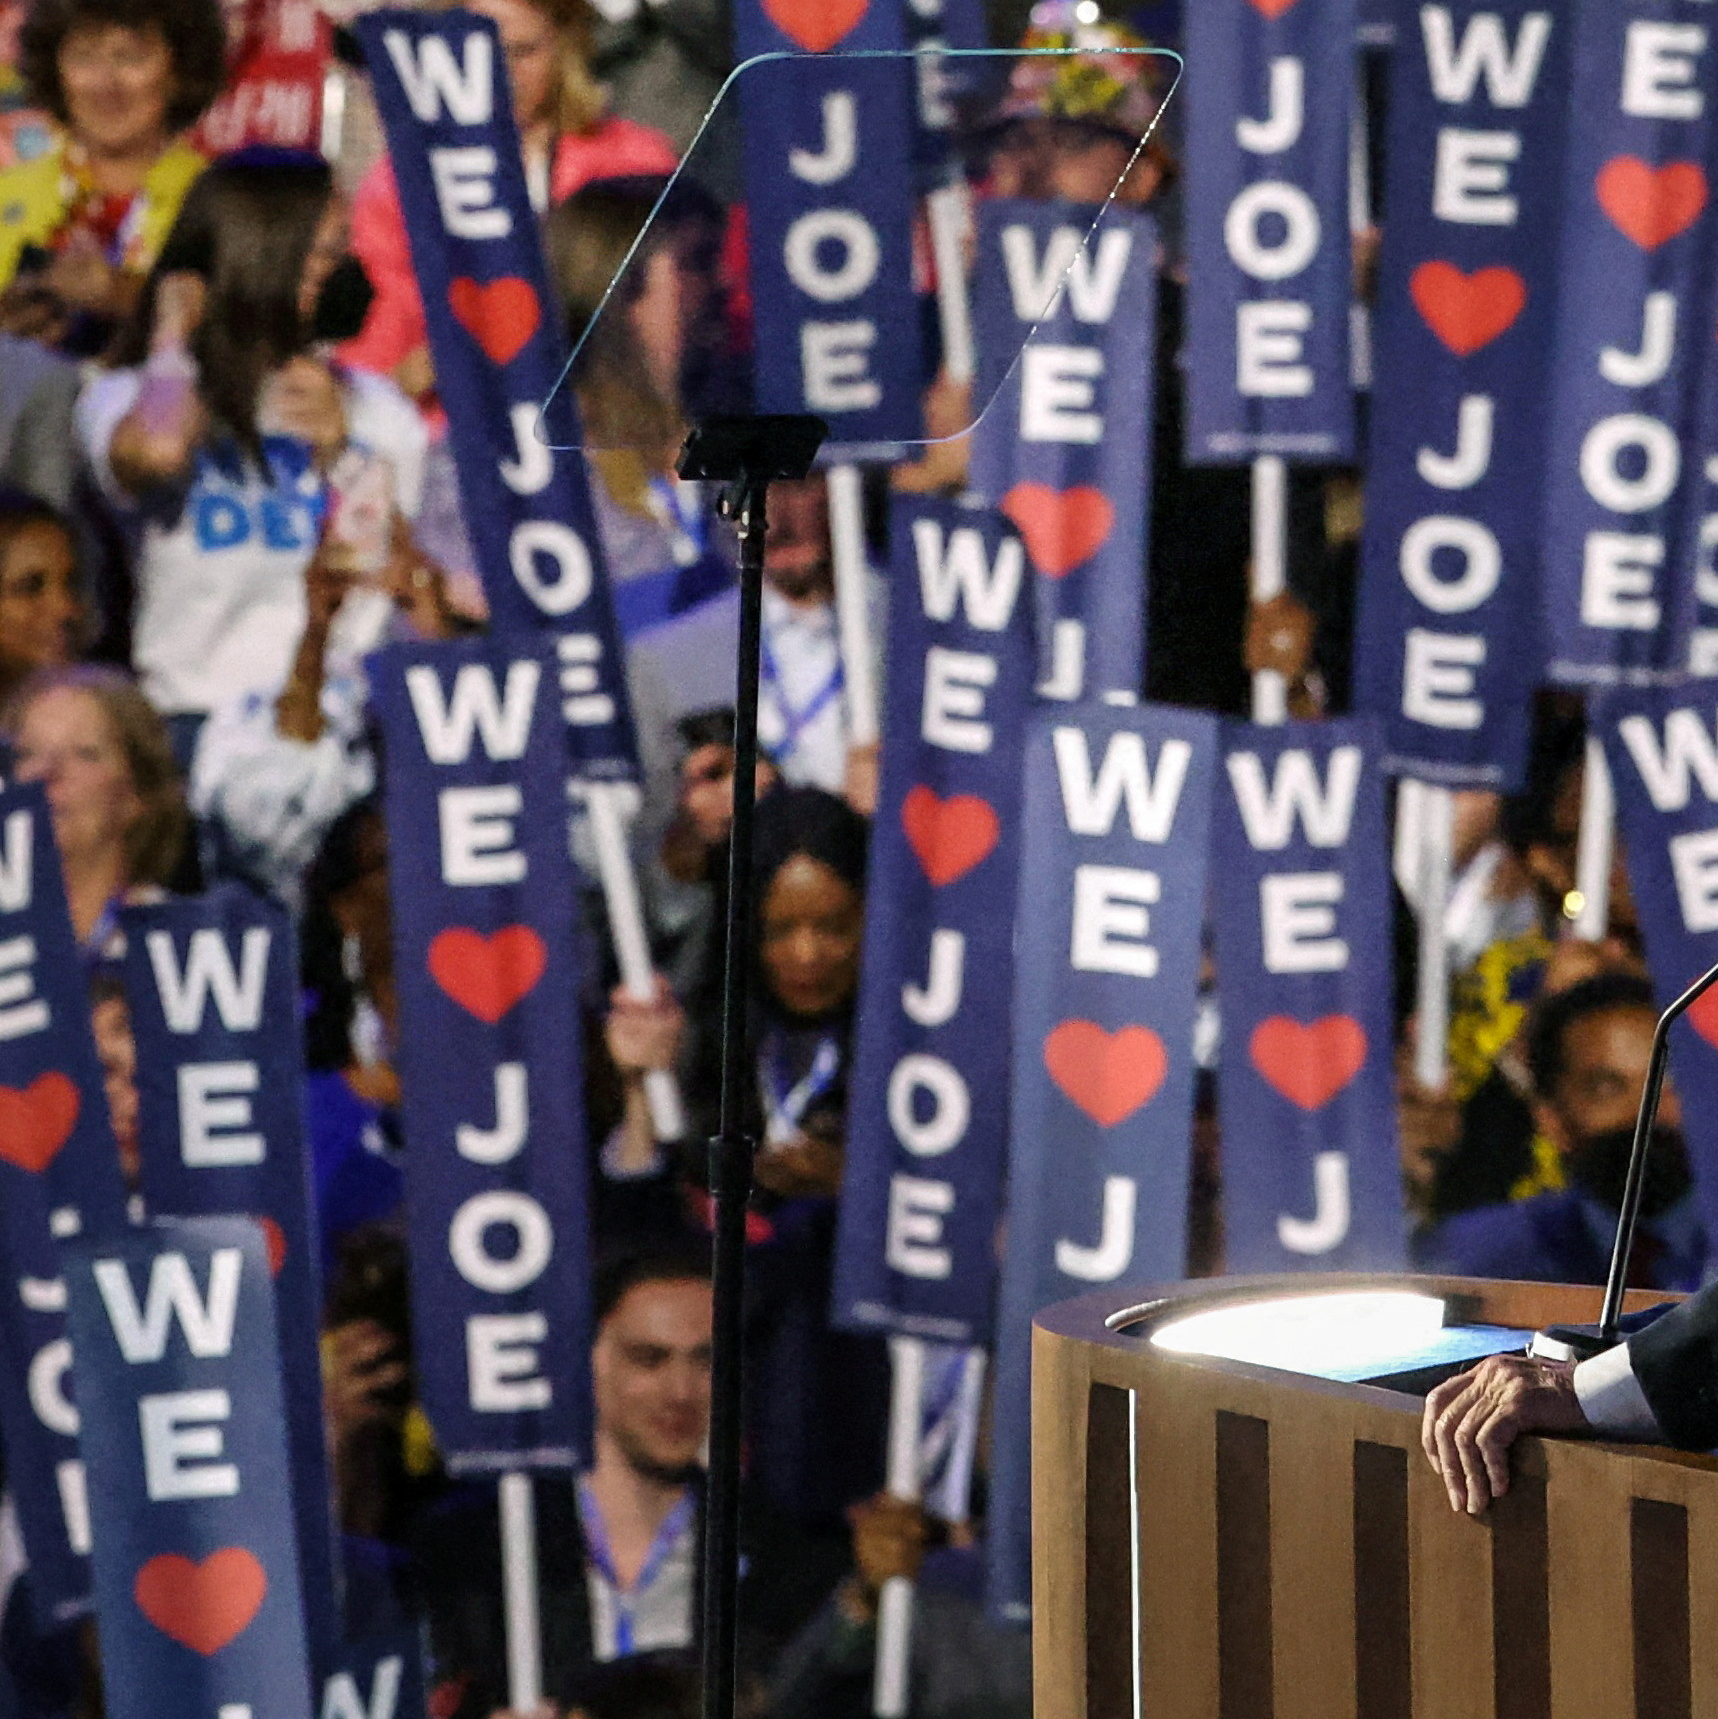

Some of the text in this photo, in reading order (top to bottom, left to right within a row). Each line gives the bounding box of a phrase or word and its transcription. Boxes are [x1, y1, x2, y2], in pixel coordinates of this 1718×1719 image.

[386, 32, 510, 238] WE
[786, 94, 878, 408] JOE
[1223, 57, 1320, 397] JOE
[1002, 225, 1134, 445] WE
[1401, 7, 1548, 728] WE JOE
[1578, 292, 1678, 629] JOE
[889, 520, 1022, 1276] WE JOE
[1050, 725, 1196, 981] WE
[1227, 745, 1362, 974] WE
[149, 929, 269, 1164] WE
[407, 661, 551, 1409] WE JOE
[92, 1248, 242, 1498] WE
